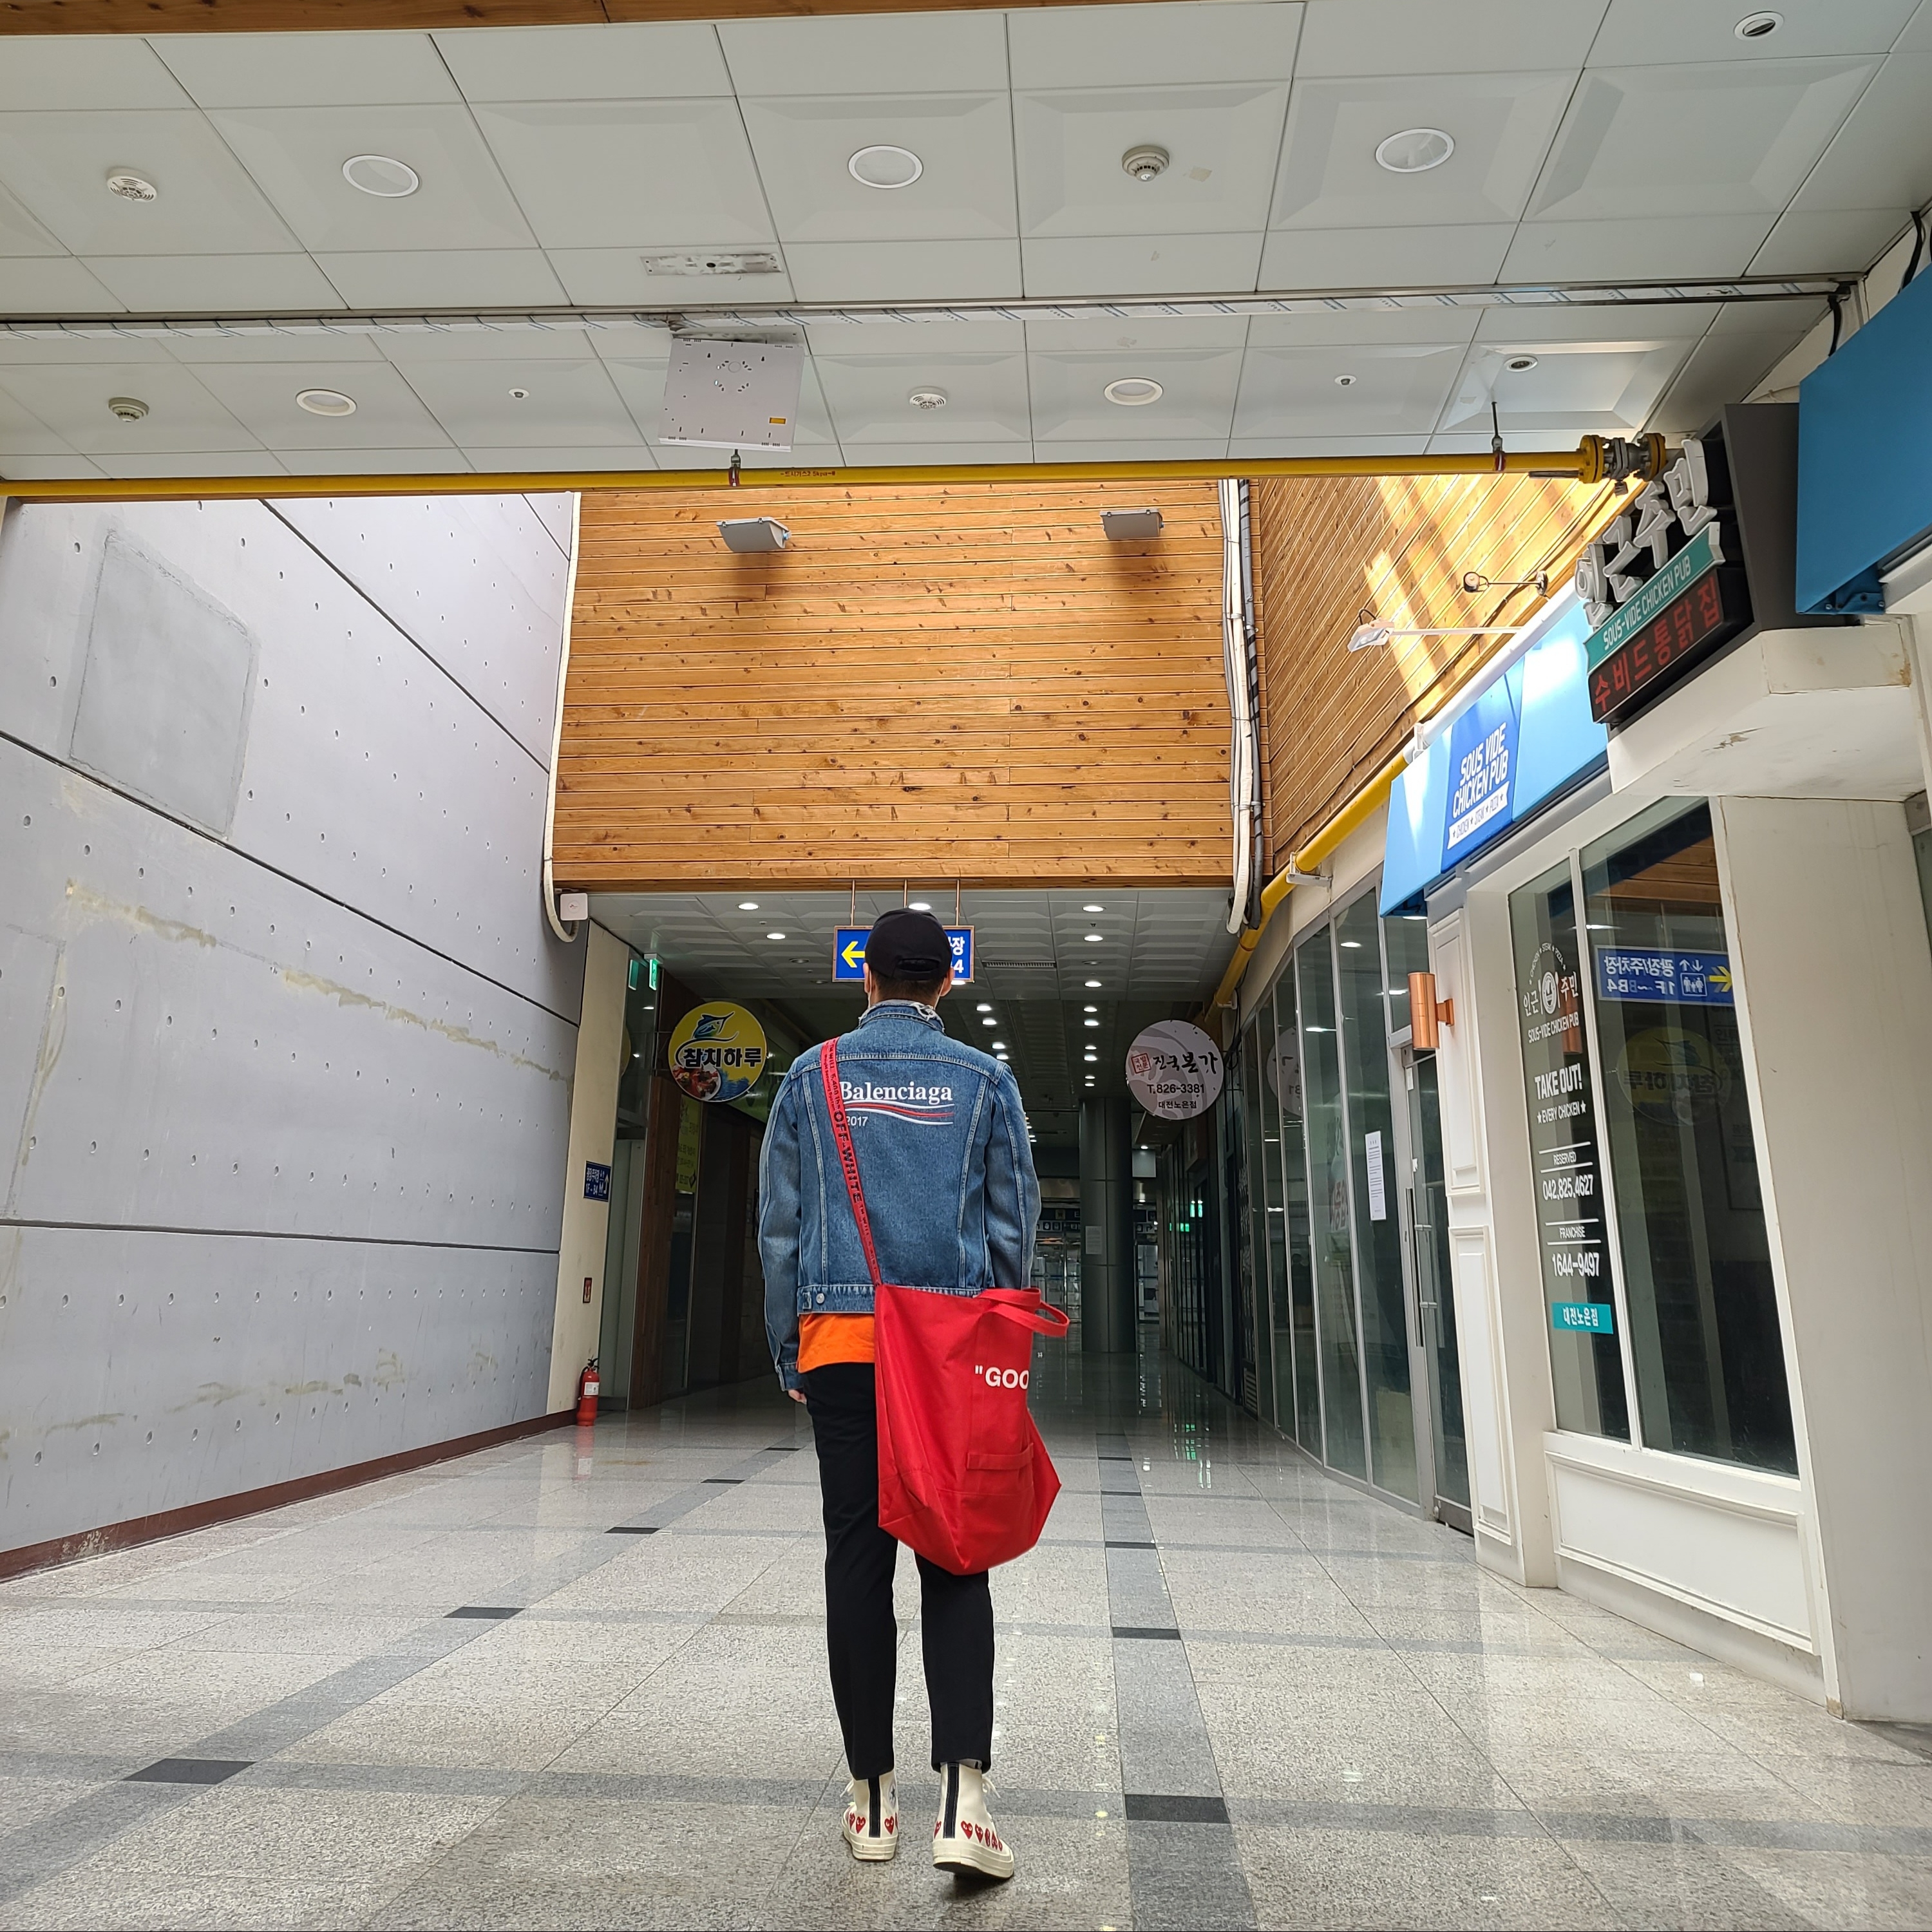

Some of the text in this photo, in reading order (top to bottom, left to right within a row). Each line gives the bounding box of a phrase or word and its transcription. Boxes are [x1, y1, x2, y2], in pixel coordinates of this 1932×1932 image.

[1575, 439, 1717, 627] 인근주민
[1603, 555, 1691, 650] SOUS-VIDE CHICKEN PUB
[1460, 722, 1506, 786] SOUS VIDE
[1452, 750, 1509, 819] CHICKEN PUB
[1524, 971, 1579, 1018] 인근 주민
[1528, 1012, 1579, 1043] SOUS-VIDE CHICKEN PUB
[683, 1048, 762, 1069] 참치하루
[840, 1081, 953, 1105] Balenciaga
[1147, 1083, 1205, 1094] T.826-3381
[1535, 1063, 1583, 1100] TAKE OUT!
[1158, 1101, 1197, 1109] 대전노은점
[1542, 1101, 1580, 1124] EVERY CHICKEN
[846, 1116, 868, 1127] 2017
[1553, 1151, 1577, 1166] RESERVED
[1542, 1174, 1593, 1200] 042.825.4627
[1559, 1226, 1586, 1239] FRANCHISE
[1552, 1253, 1600, 1277] 1644-9497
